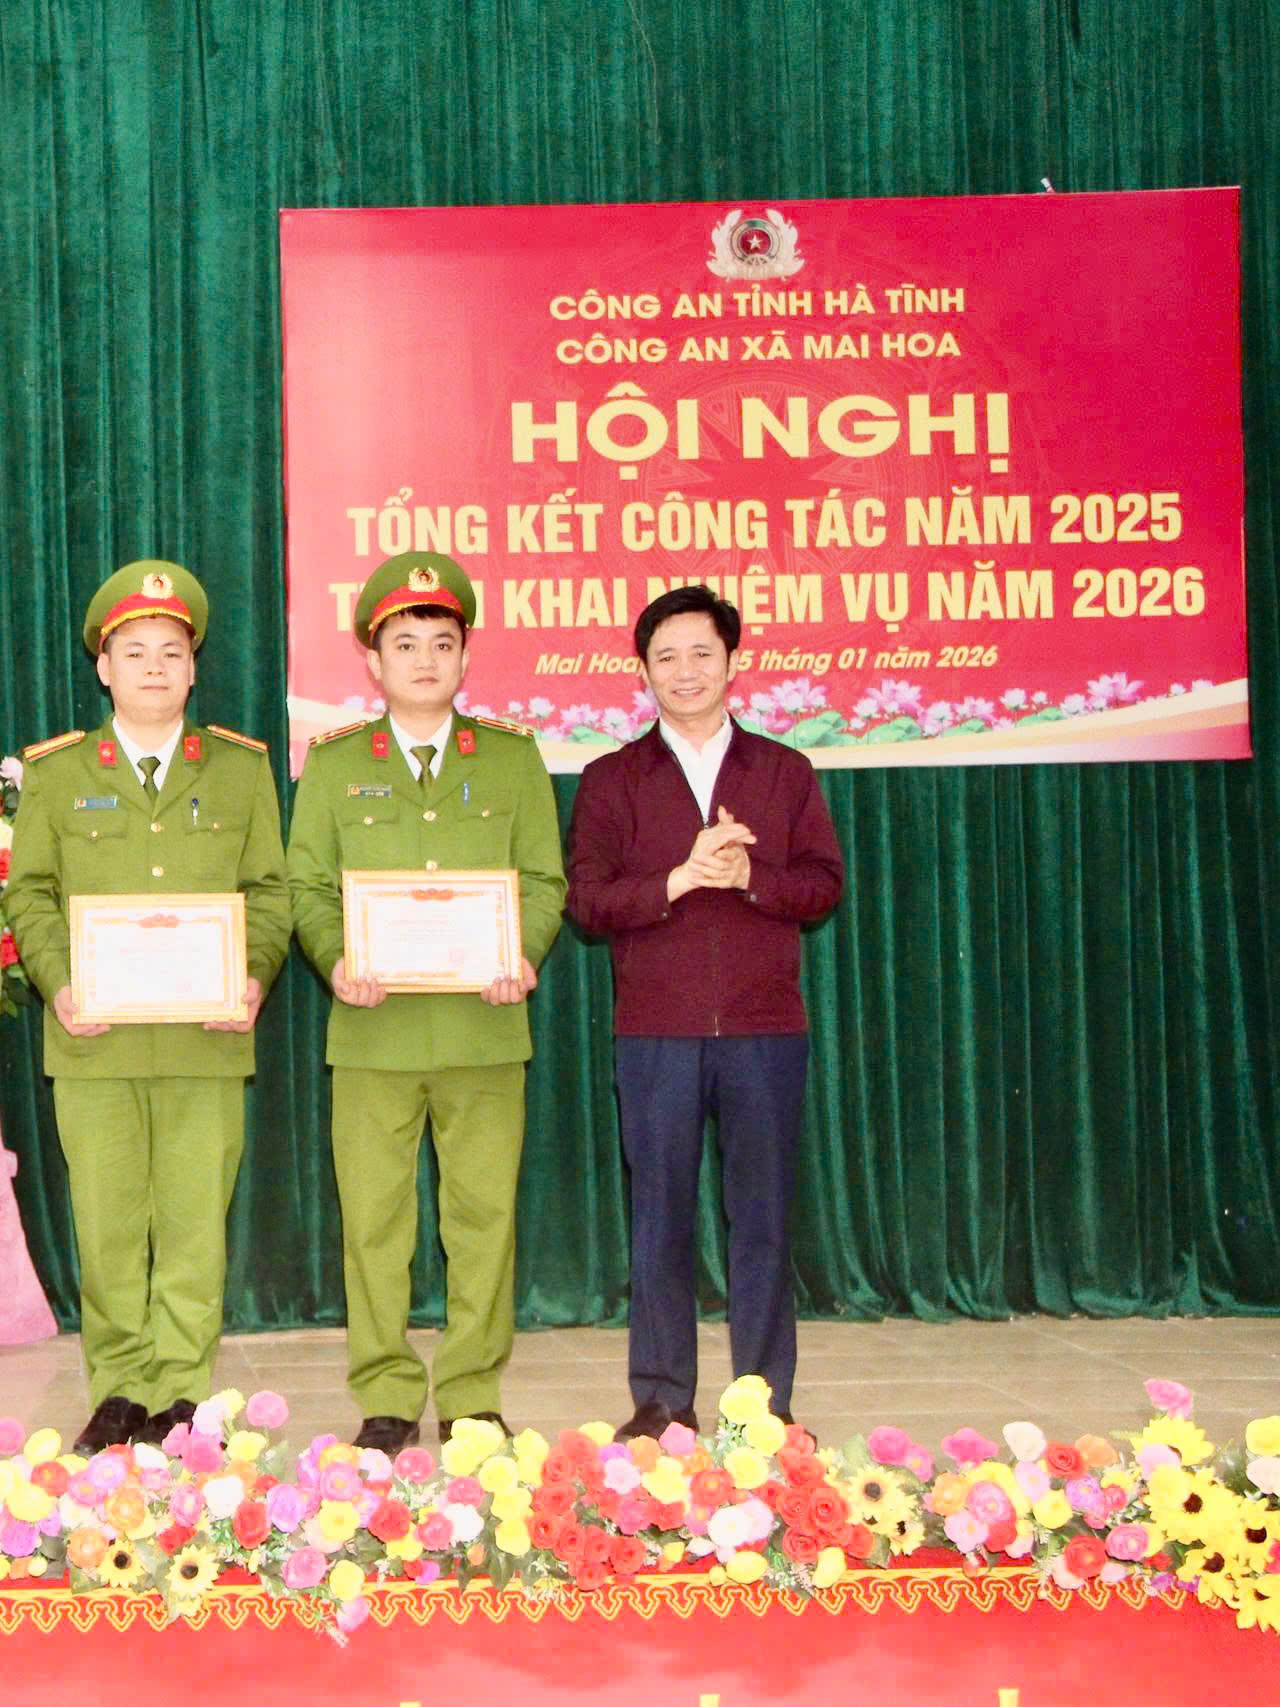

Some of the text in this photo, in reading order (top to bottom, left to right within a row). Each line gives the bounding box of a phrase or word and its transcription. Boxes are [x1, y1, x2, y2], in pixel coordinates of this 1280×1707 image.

[550, 283, 964, 320] CÔNG AN TỈNH HÀ TĨNH
[556, 330, 961, 364] CÔNG AN XÃ MAI HOA
[511, 382, 1010, 480] HỘI NGHỊ
[347, 485, 1182, 556] TỔNG KẾT CÔNG TÁC NĂM 2025
[504, 577, 628, 629] KHAI
[840, 573, 909, 633] VỤ
[928, 561, 1054, 621] NĂM
[1073, 567, 1206, 618] 2026
[535, 653, 584, 675] Mai
[736, 650, 754, 672] 5
[759, 648, 833, 675] tháng
[838, 648, 868, 670] 01
[875, 647, 930, 669] năm
[936, 646, 998, 668] 2026
